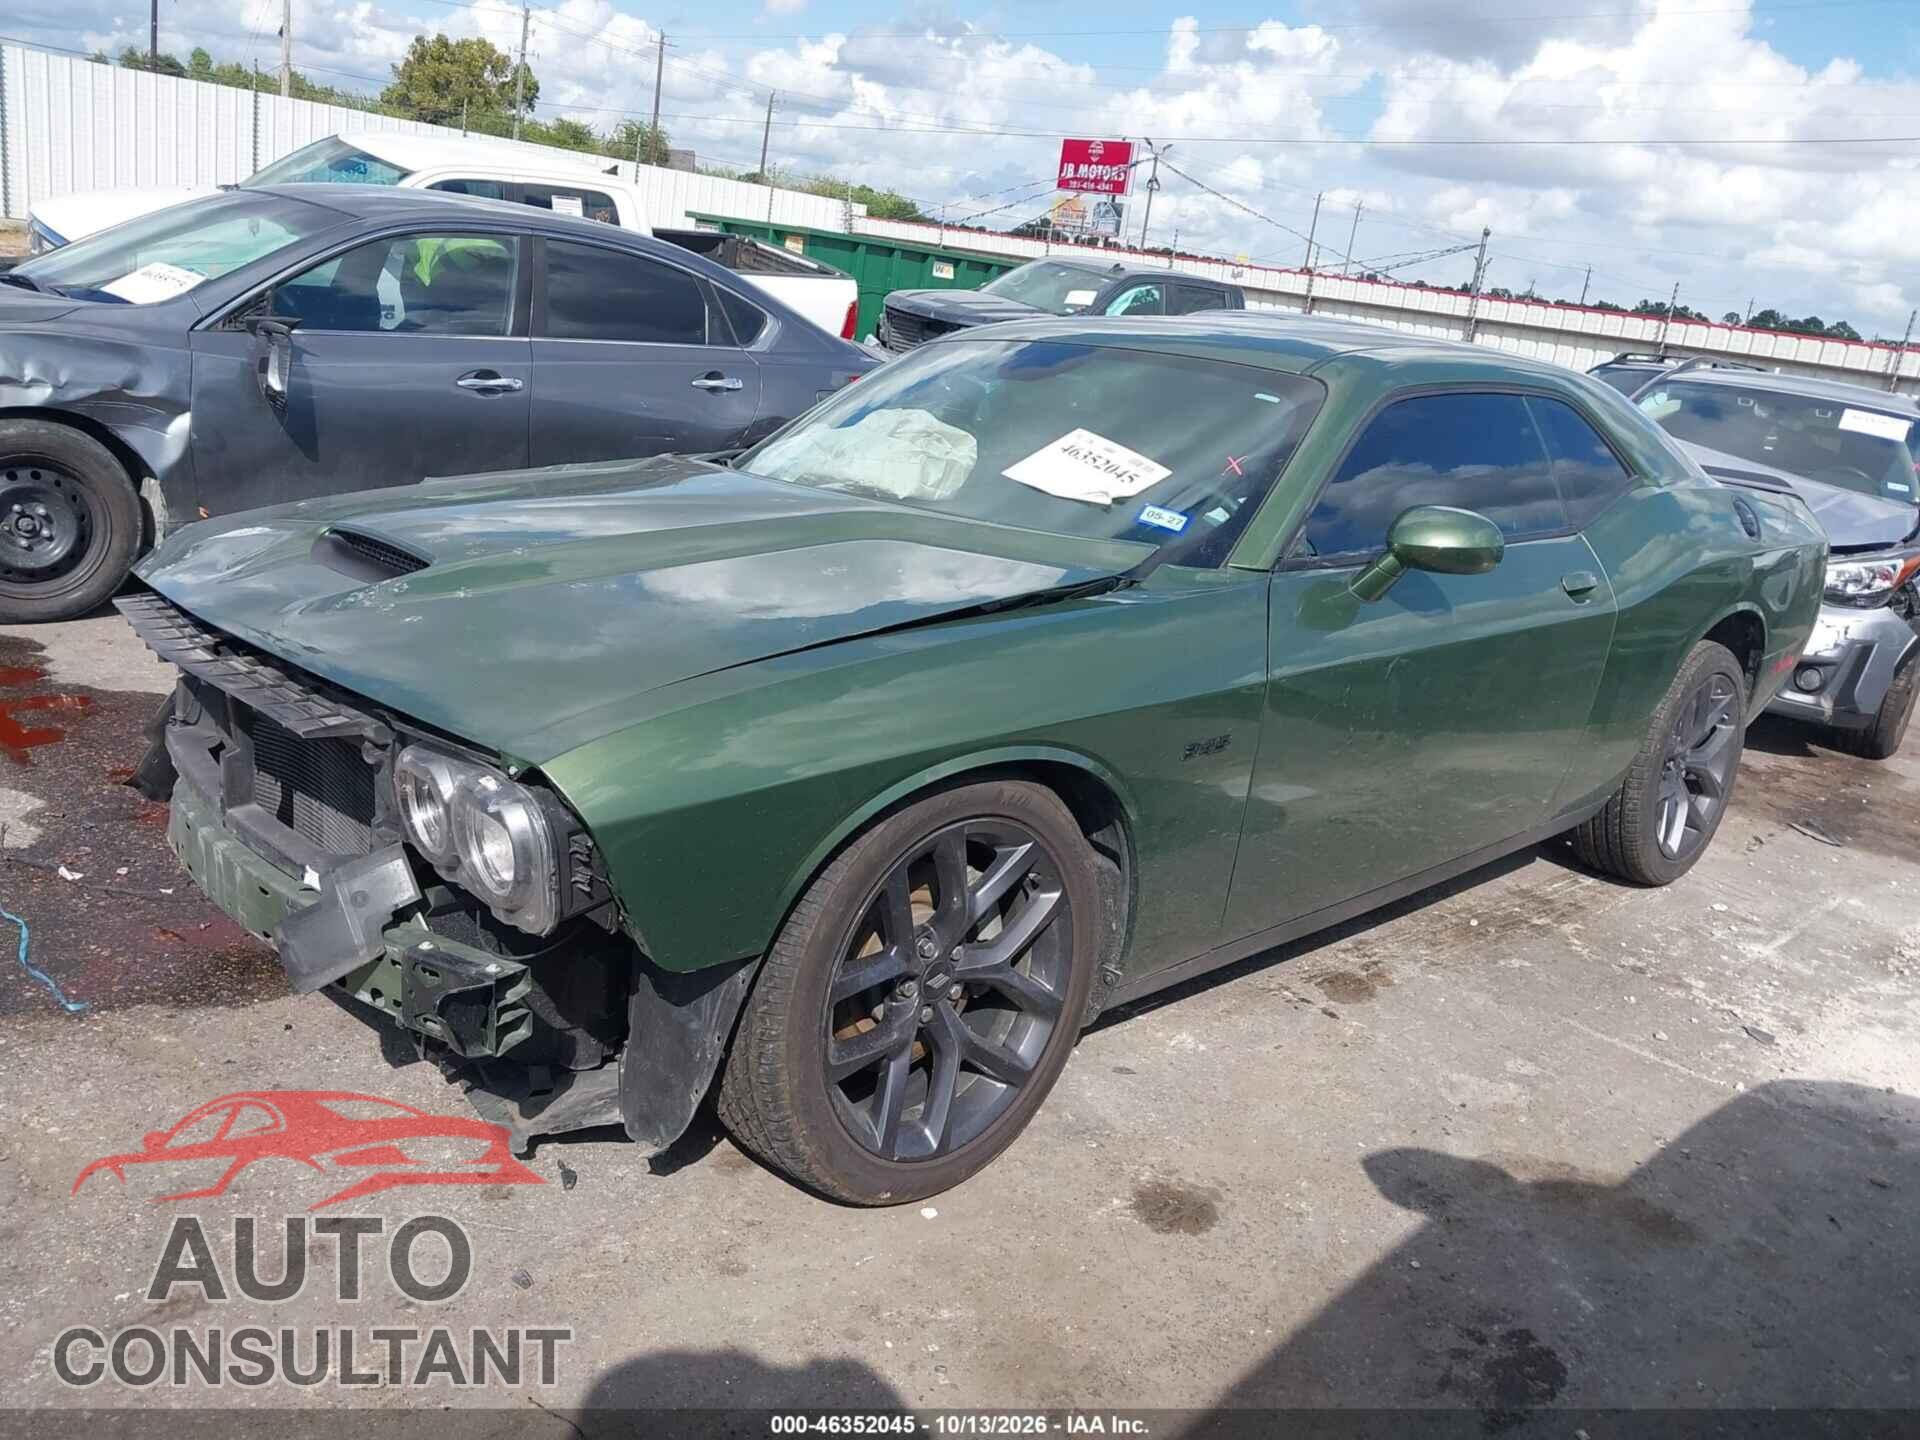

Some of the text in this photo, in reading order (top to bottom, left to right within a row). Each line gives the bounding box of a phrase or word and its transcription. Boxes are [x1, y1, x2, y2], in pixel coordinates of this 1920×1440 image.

[1061, 162, 1126, 181] JB MOTORS
[1060, 444, 1141, 483] 46352045
